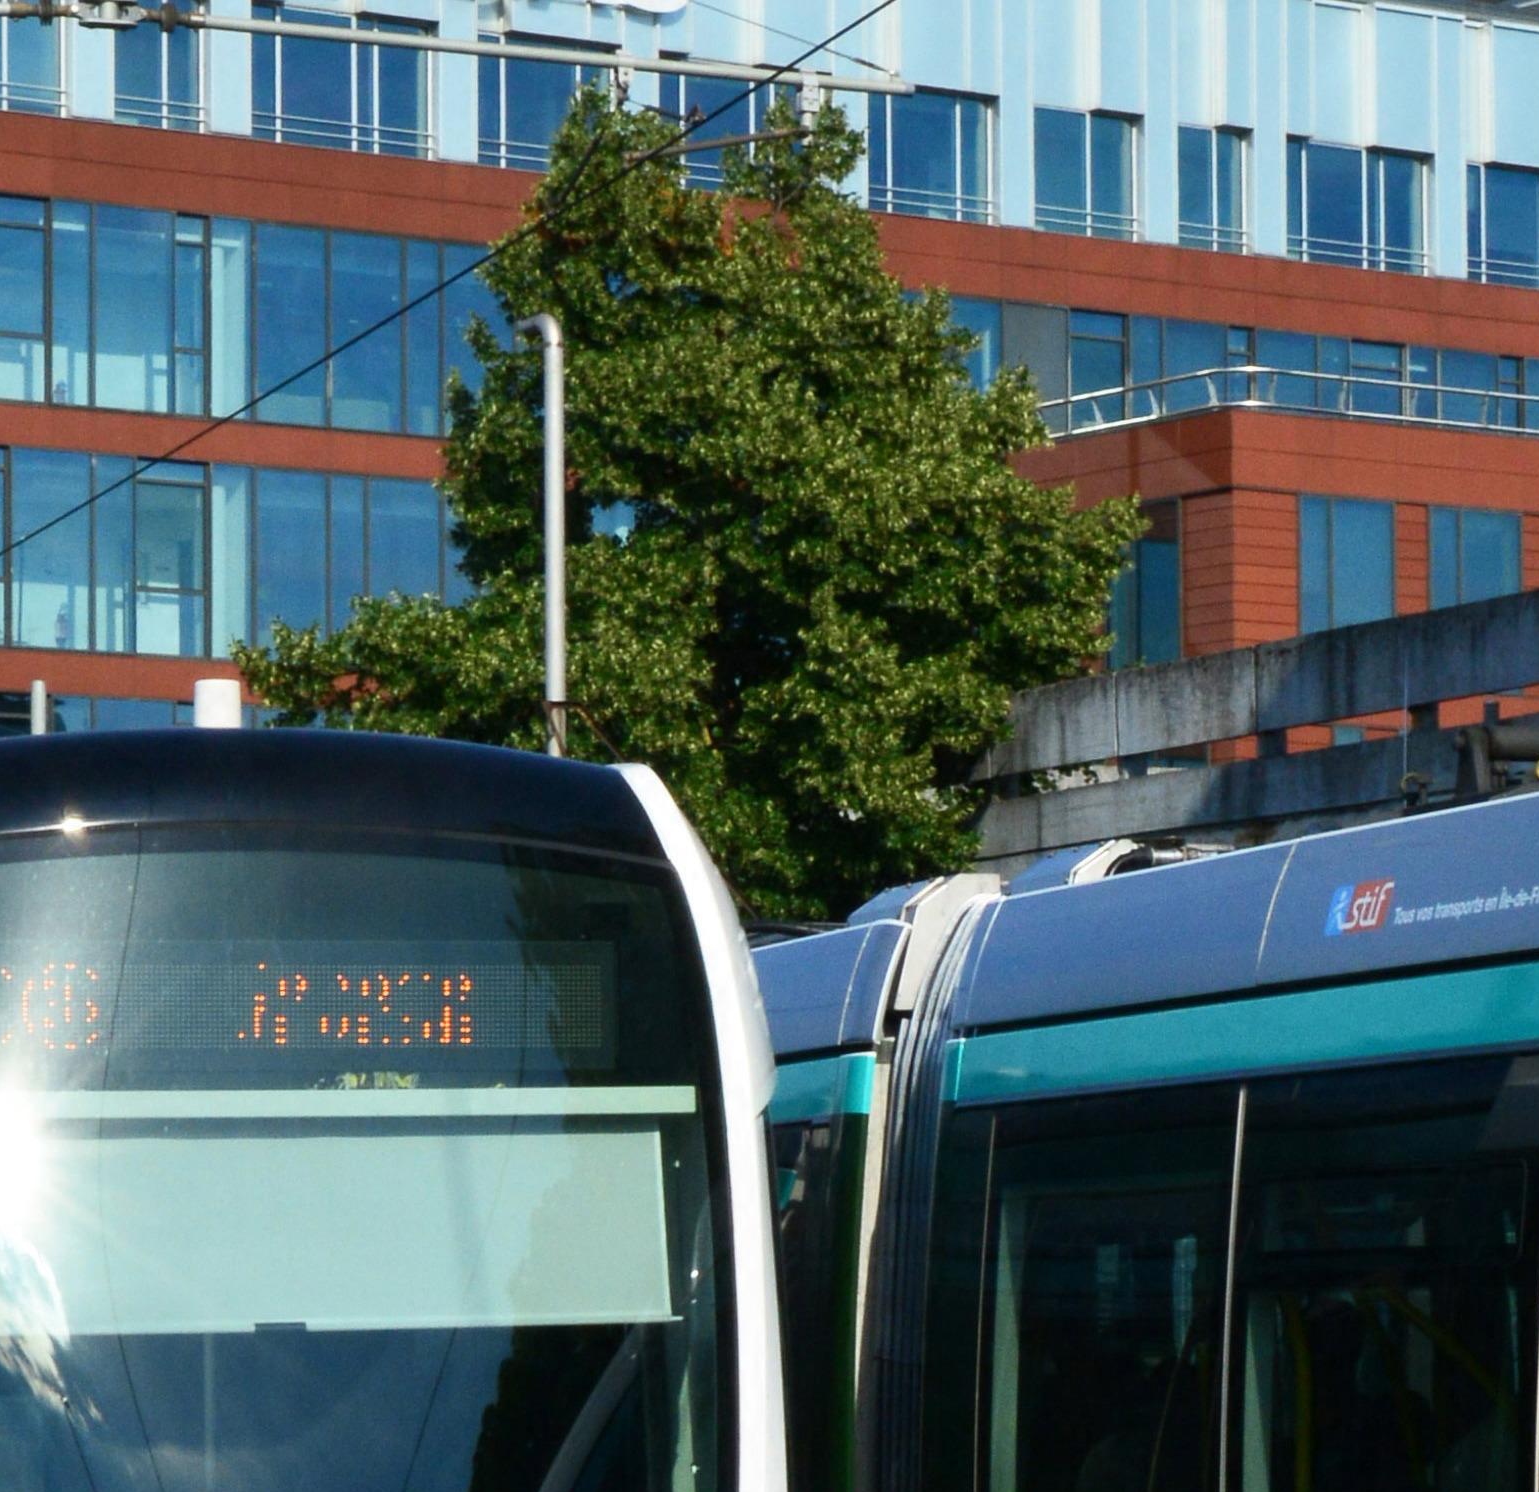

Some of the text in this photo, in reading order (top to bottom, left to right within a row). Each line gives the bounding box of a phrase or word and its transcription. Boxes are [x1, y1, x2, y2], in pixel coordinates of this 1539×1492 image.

[1394, 907, 1415, 926] Tous
[1416, 906, 1434, 922] vos
[1435, 896, 1484, 921] transports
